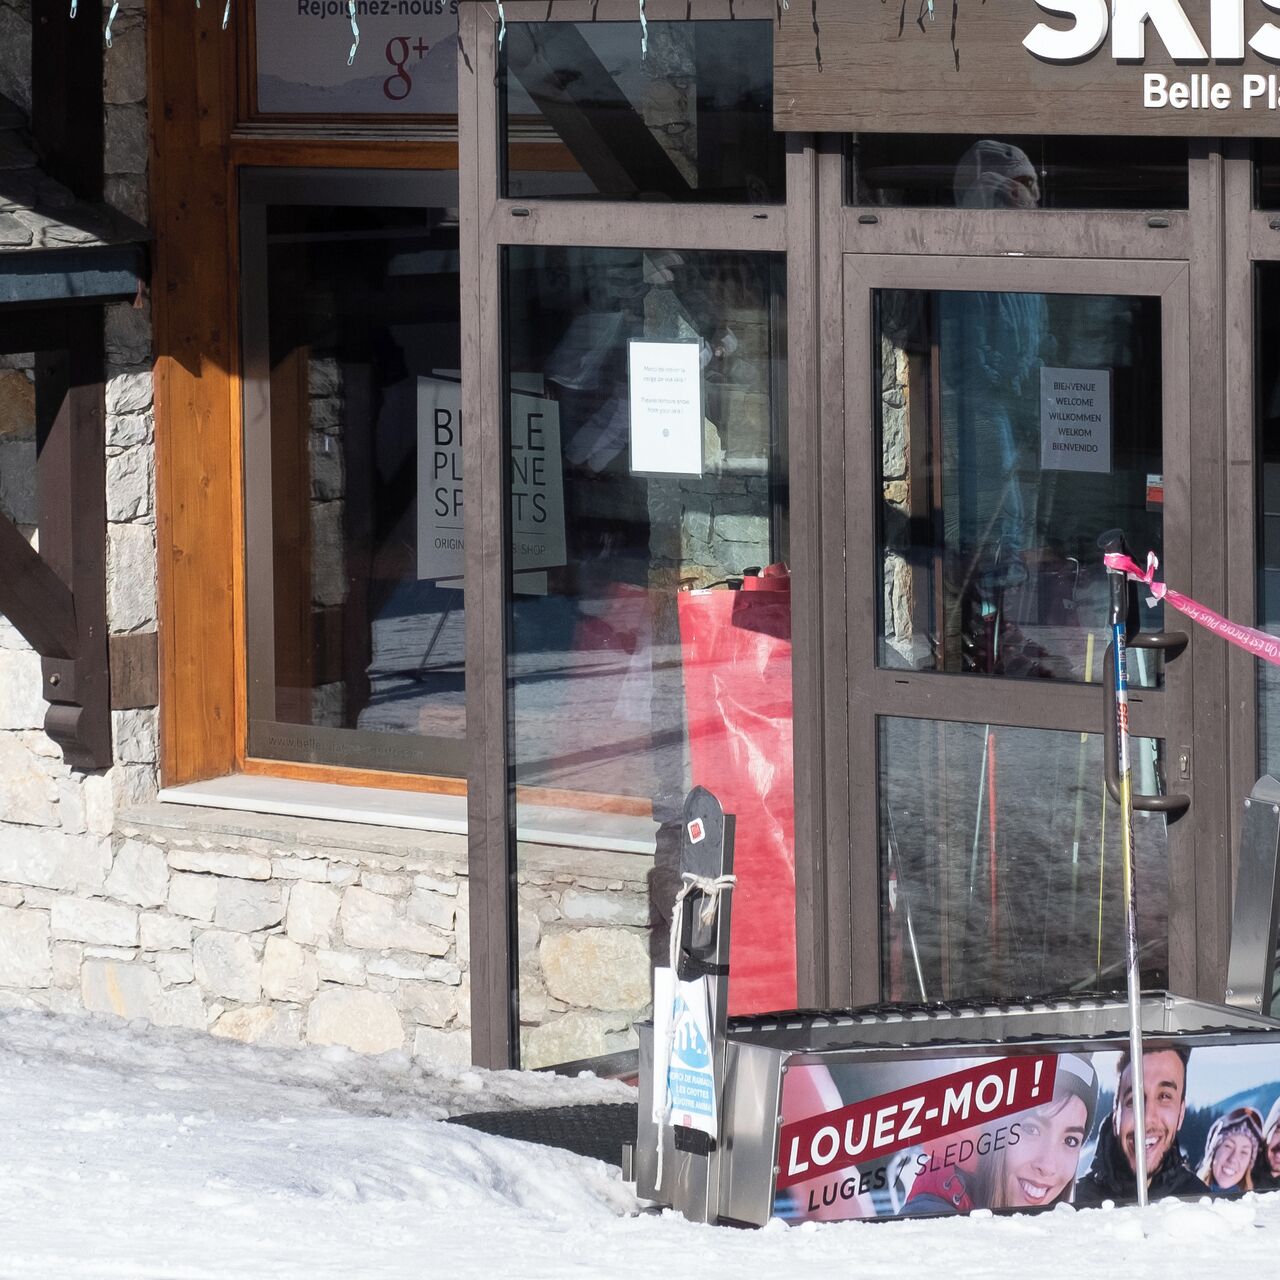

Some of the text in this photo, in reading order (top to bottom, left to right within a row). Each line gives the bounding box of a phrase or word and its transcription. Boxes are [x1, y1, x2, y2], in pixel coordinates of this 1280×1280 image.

[1142, 73, 1231, 110] Belle
[1053, 382, 1096, 391] BIENVENUE
[1055, 397, 1094, 407] WELCOME
[1049, 412, 1101, 422] WILLKOMMEN
[1058, 428, 1092, 437] WELKOM
[1052, 442, 1098, 452] BIENVENIDO
[1200, 612, 1220, 629] Plus
[788, 1067, 1018, 1176] LOUEZ-MOI
[807, 1166, 886, 1213] LUGES
[914, 1122, 1021, 1177] SLEDGES
